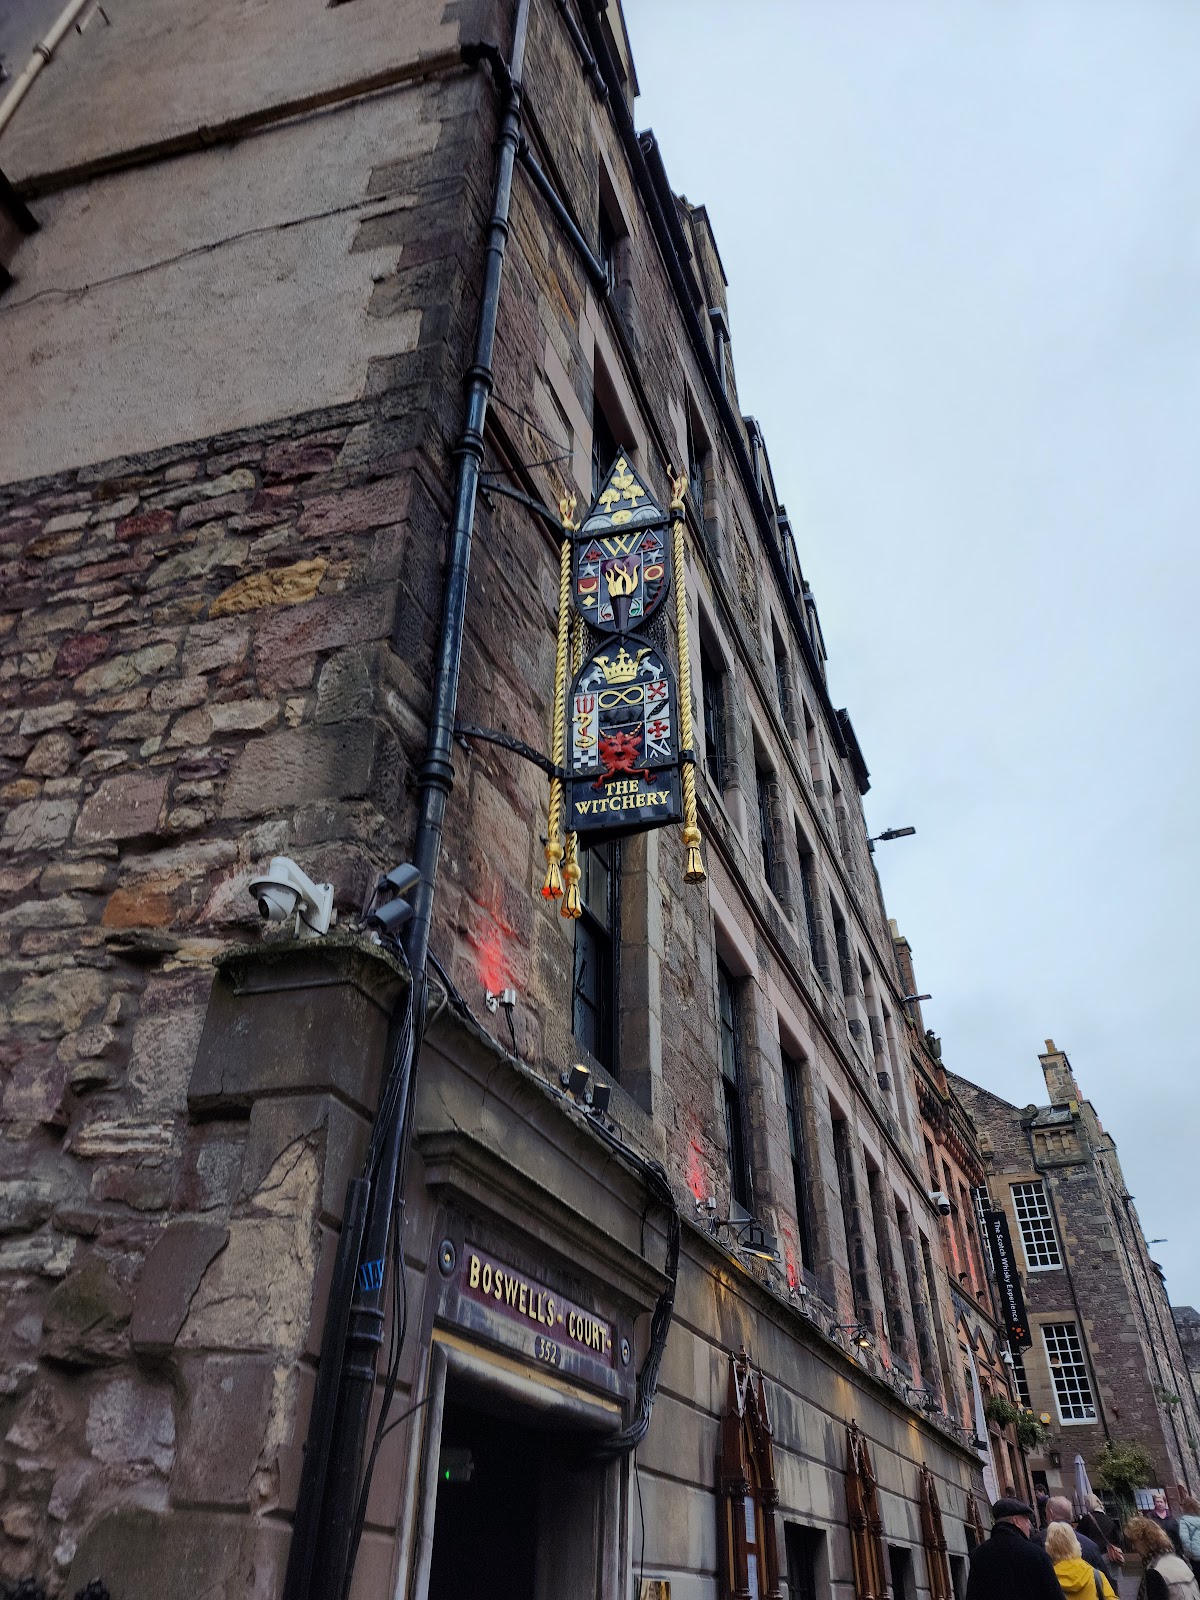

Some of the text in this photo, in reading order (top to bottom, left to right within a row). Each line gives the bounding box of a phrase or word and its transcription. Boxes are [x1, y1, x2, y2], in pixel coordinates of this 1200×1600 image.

[600, 532, 641, 556] W
[605, 780, 639, 796] THE
[575, 791, 670, 815] WITCHERY
[993, 1220, 1019, 1322] The Scotch Whisky Experience
[568, 1311, 607, 1354] COURT
[538, 1338, 557, 1363] 352
